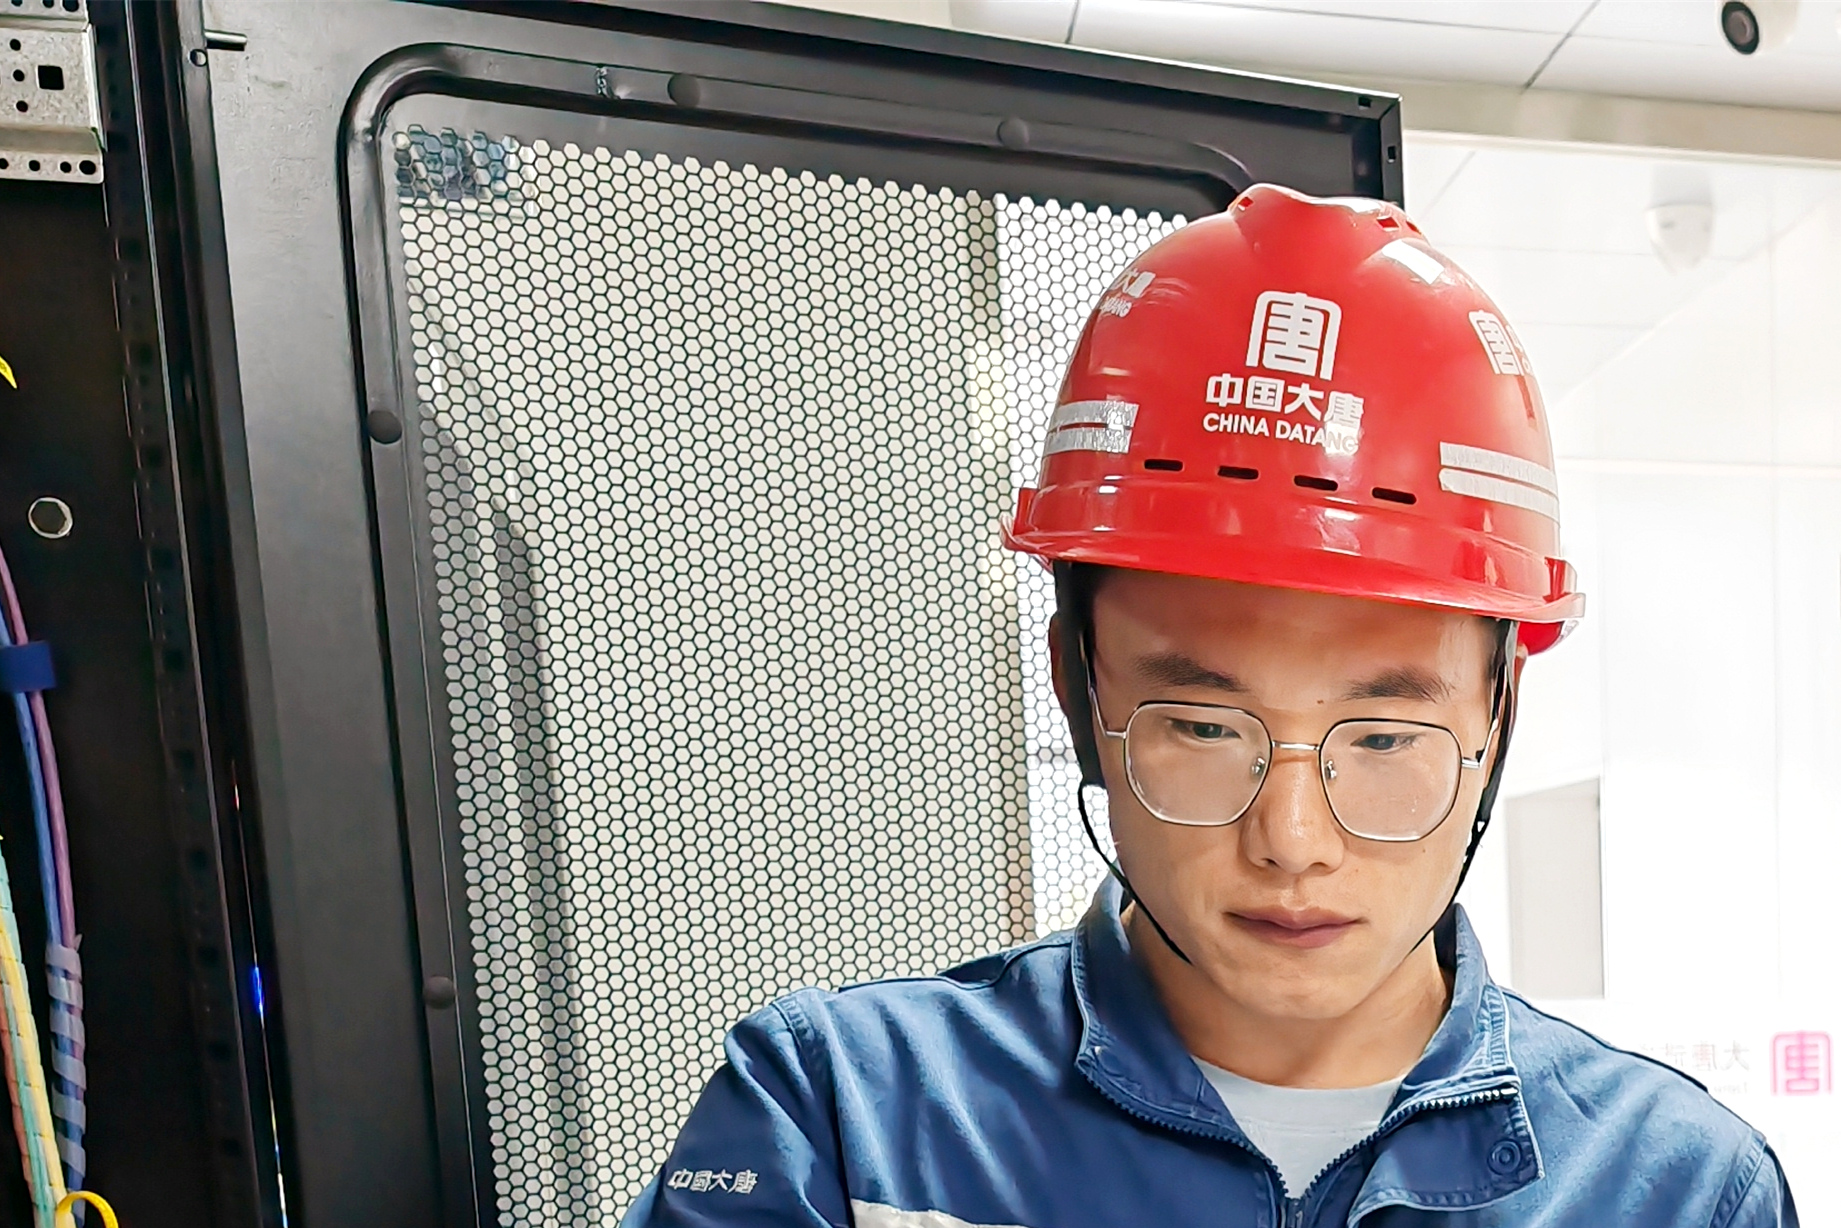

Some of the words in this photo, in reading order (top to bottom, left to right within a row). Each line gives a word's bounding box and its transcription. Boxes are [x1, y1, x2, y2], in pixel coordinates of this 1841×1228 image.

[1205, 373, 1365, 429] 中国大唐
[1202, 412, 1270, 437] CHINA
[1275, 419, 1360, 454] DATANG
